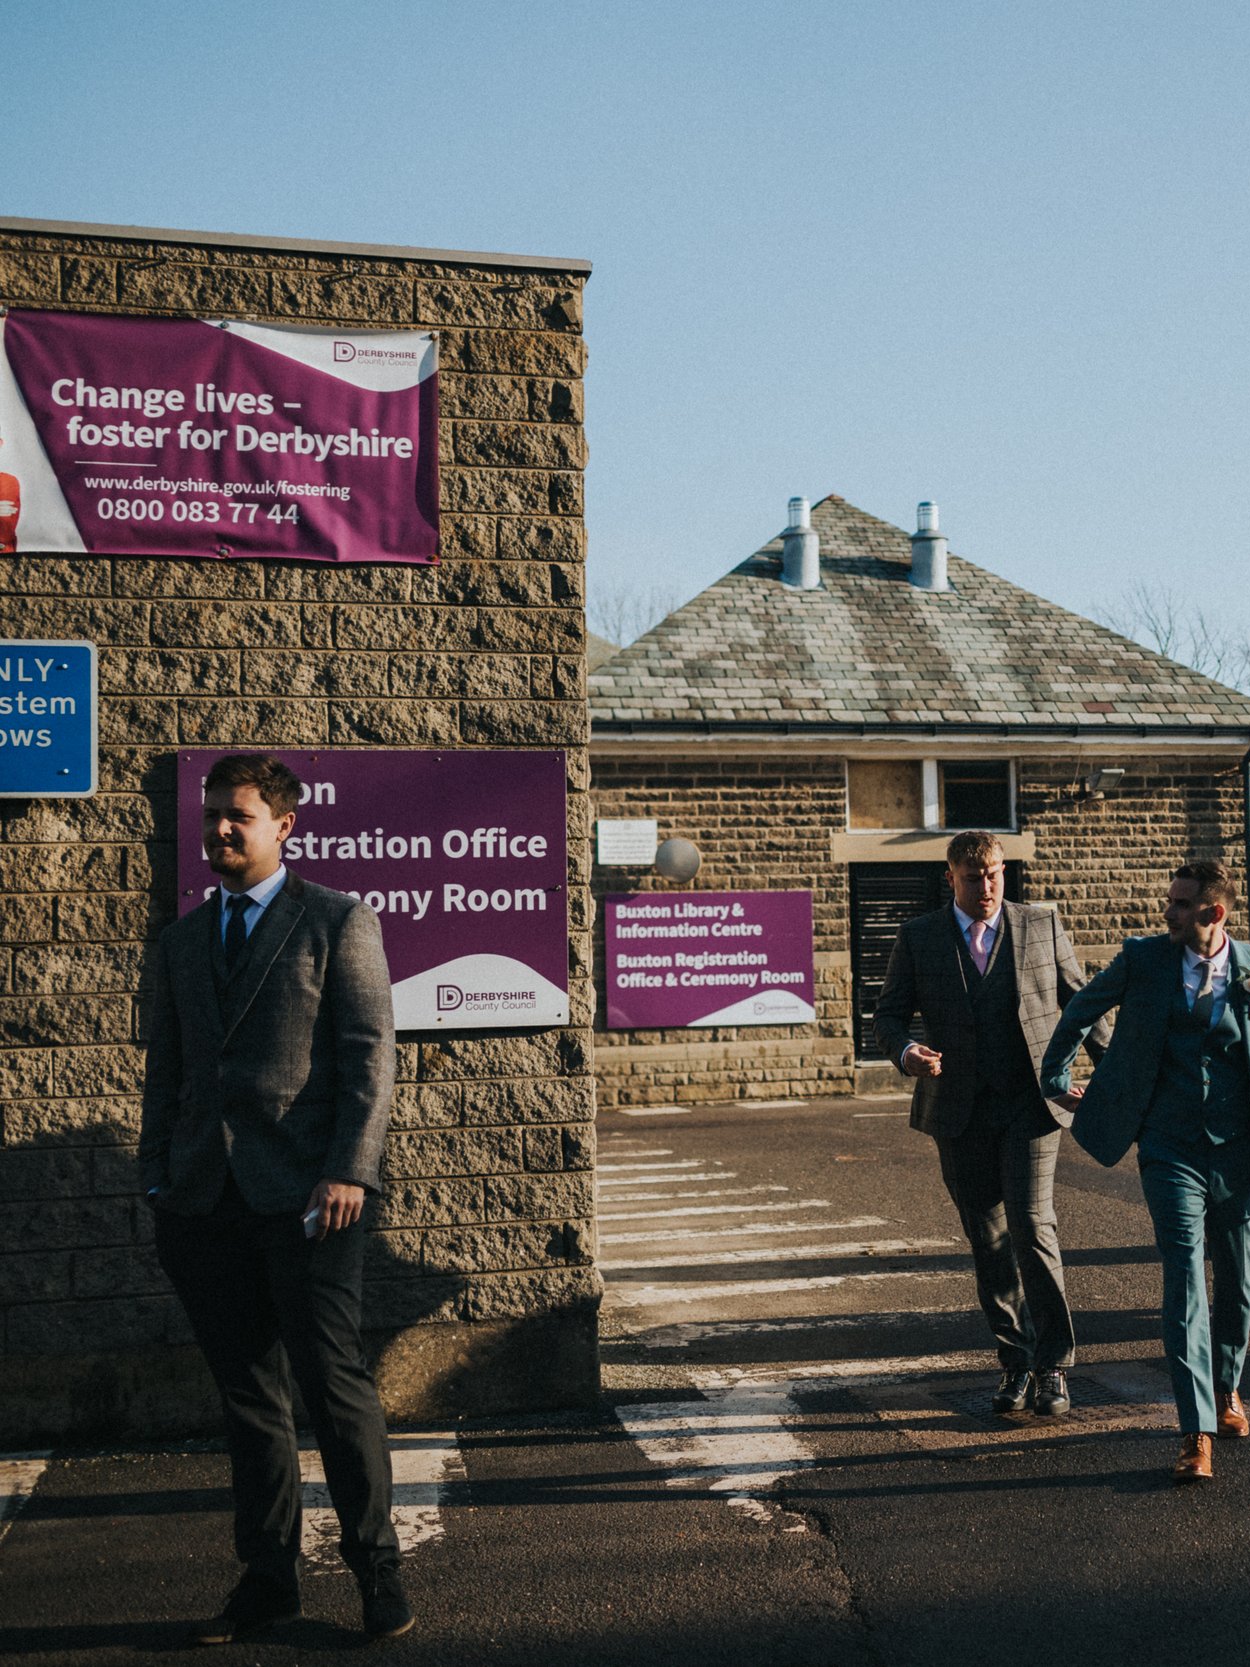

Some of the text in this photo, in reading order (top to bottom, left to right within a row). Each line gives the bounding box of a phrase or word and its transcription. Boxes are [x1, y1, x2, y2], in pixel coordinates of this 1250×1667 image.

[357, 358, 418, 367] County Council
[358, 349, 417, 360] DERBYSHIRE
[51, 378, 186, 418] Change
[195, 383, 274, 415] lives
[66, 416, 414, 463] foster for Derbyshire
[84, 475, 351, 501] www.derbyshire.gov.uk/fostering
[97, 498, 299, 525] 0800 083 77 44
[0, 657, 55, 682] NLY
[0, 691, 76, 715] stem
[279, 827, 548, 860] stration Office
[443, 883, 547, 912] Room
[616, 903, 745, 920] Buxton Library &
[616, 923, 763, 938] Information Centre
[616, 951, 768, 970] Buxton Registration
[616, 970, 805, 988] Office & Ceremony Room
[465, 991, 536, 1001] DERBYSHIRE
[465, 1001, 536, 1012] County Council
